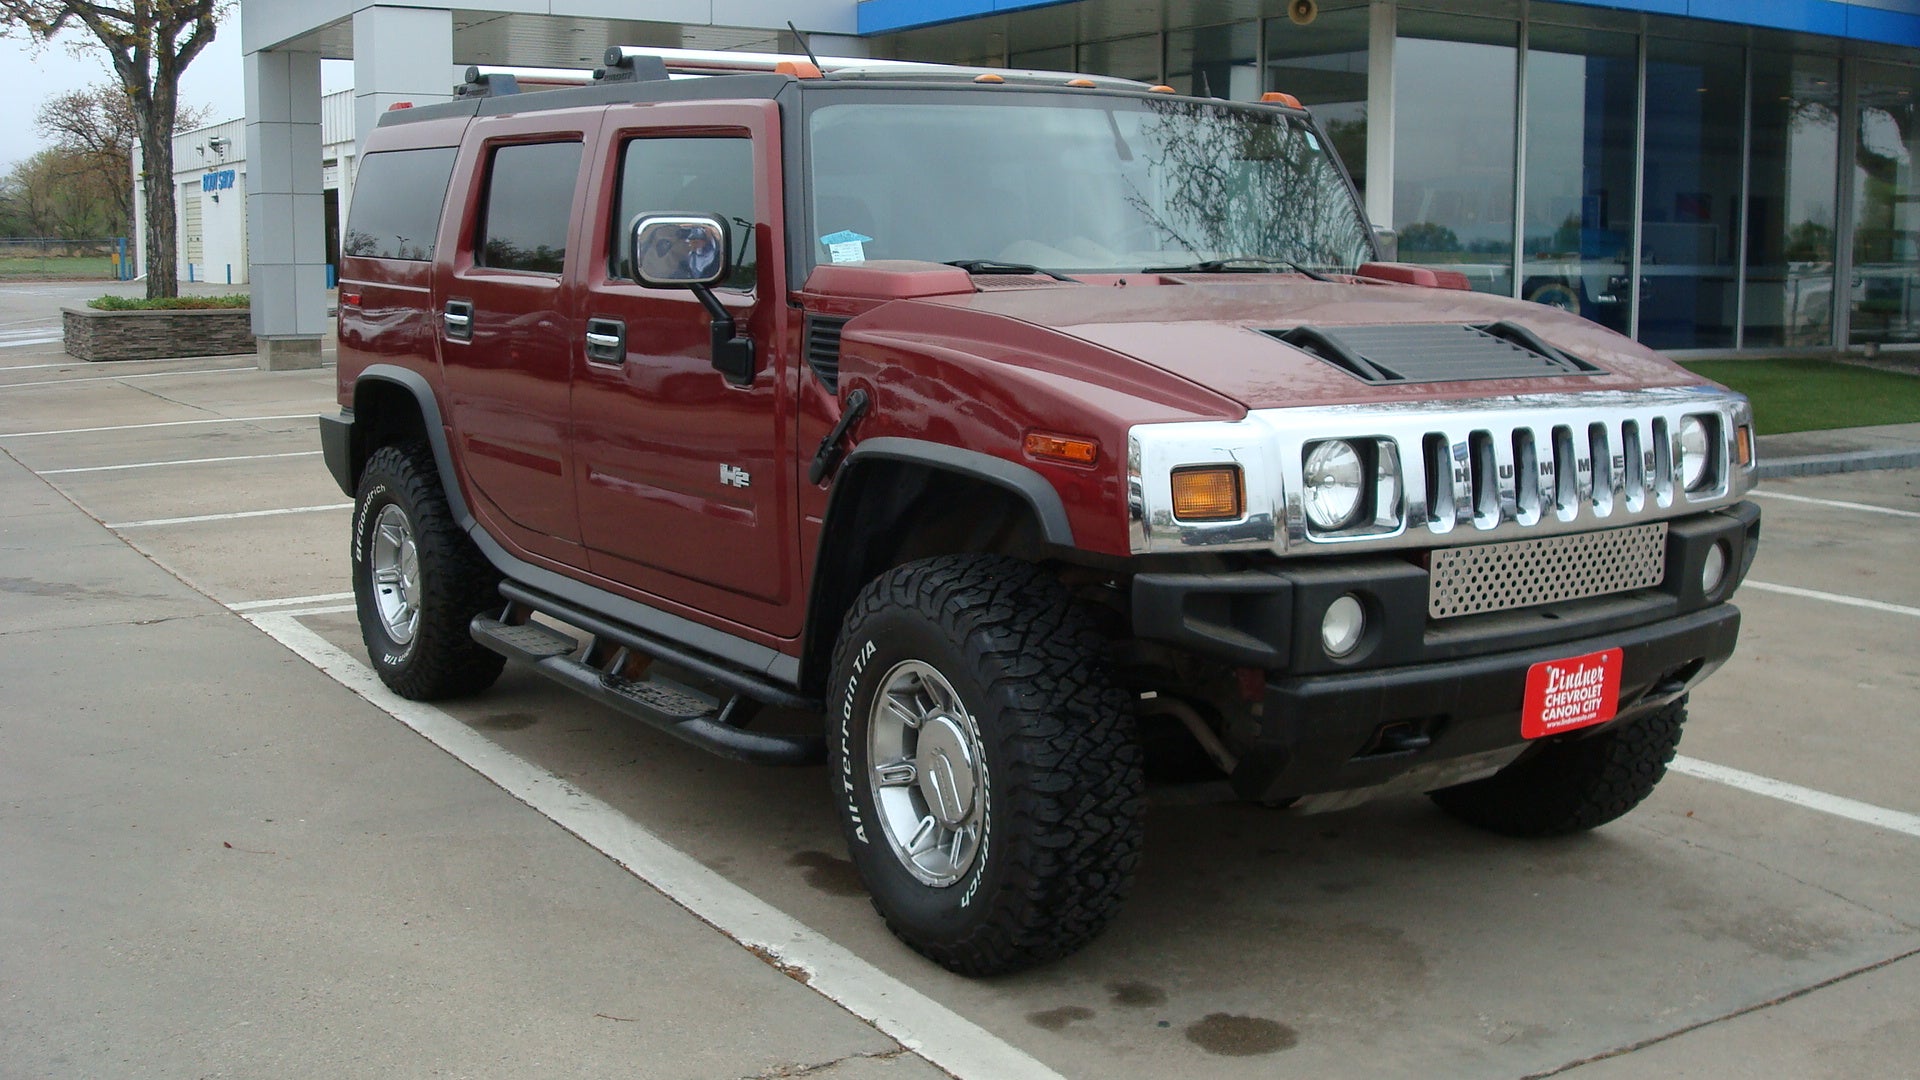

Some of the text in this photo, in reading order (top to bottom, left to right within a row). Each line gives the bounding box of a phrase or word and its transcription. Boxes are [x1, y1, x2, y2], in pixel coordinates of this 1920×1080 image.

[719, 463, 750, 488] H2
[1455, 450, 1656, 482] HUMMER
[356, 483, 386, 563] BFGoodrich
[1545, 662, 1604, 694] Lindner
[1542, 698, 1603, 722] CANON CITY
[1545, 683, 1603, 708] CHEVROLET
[840, 639, 877, 845] All-Terrain T/A
